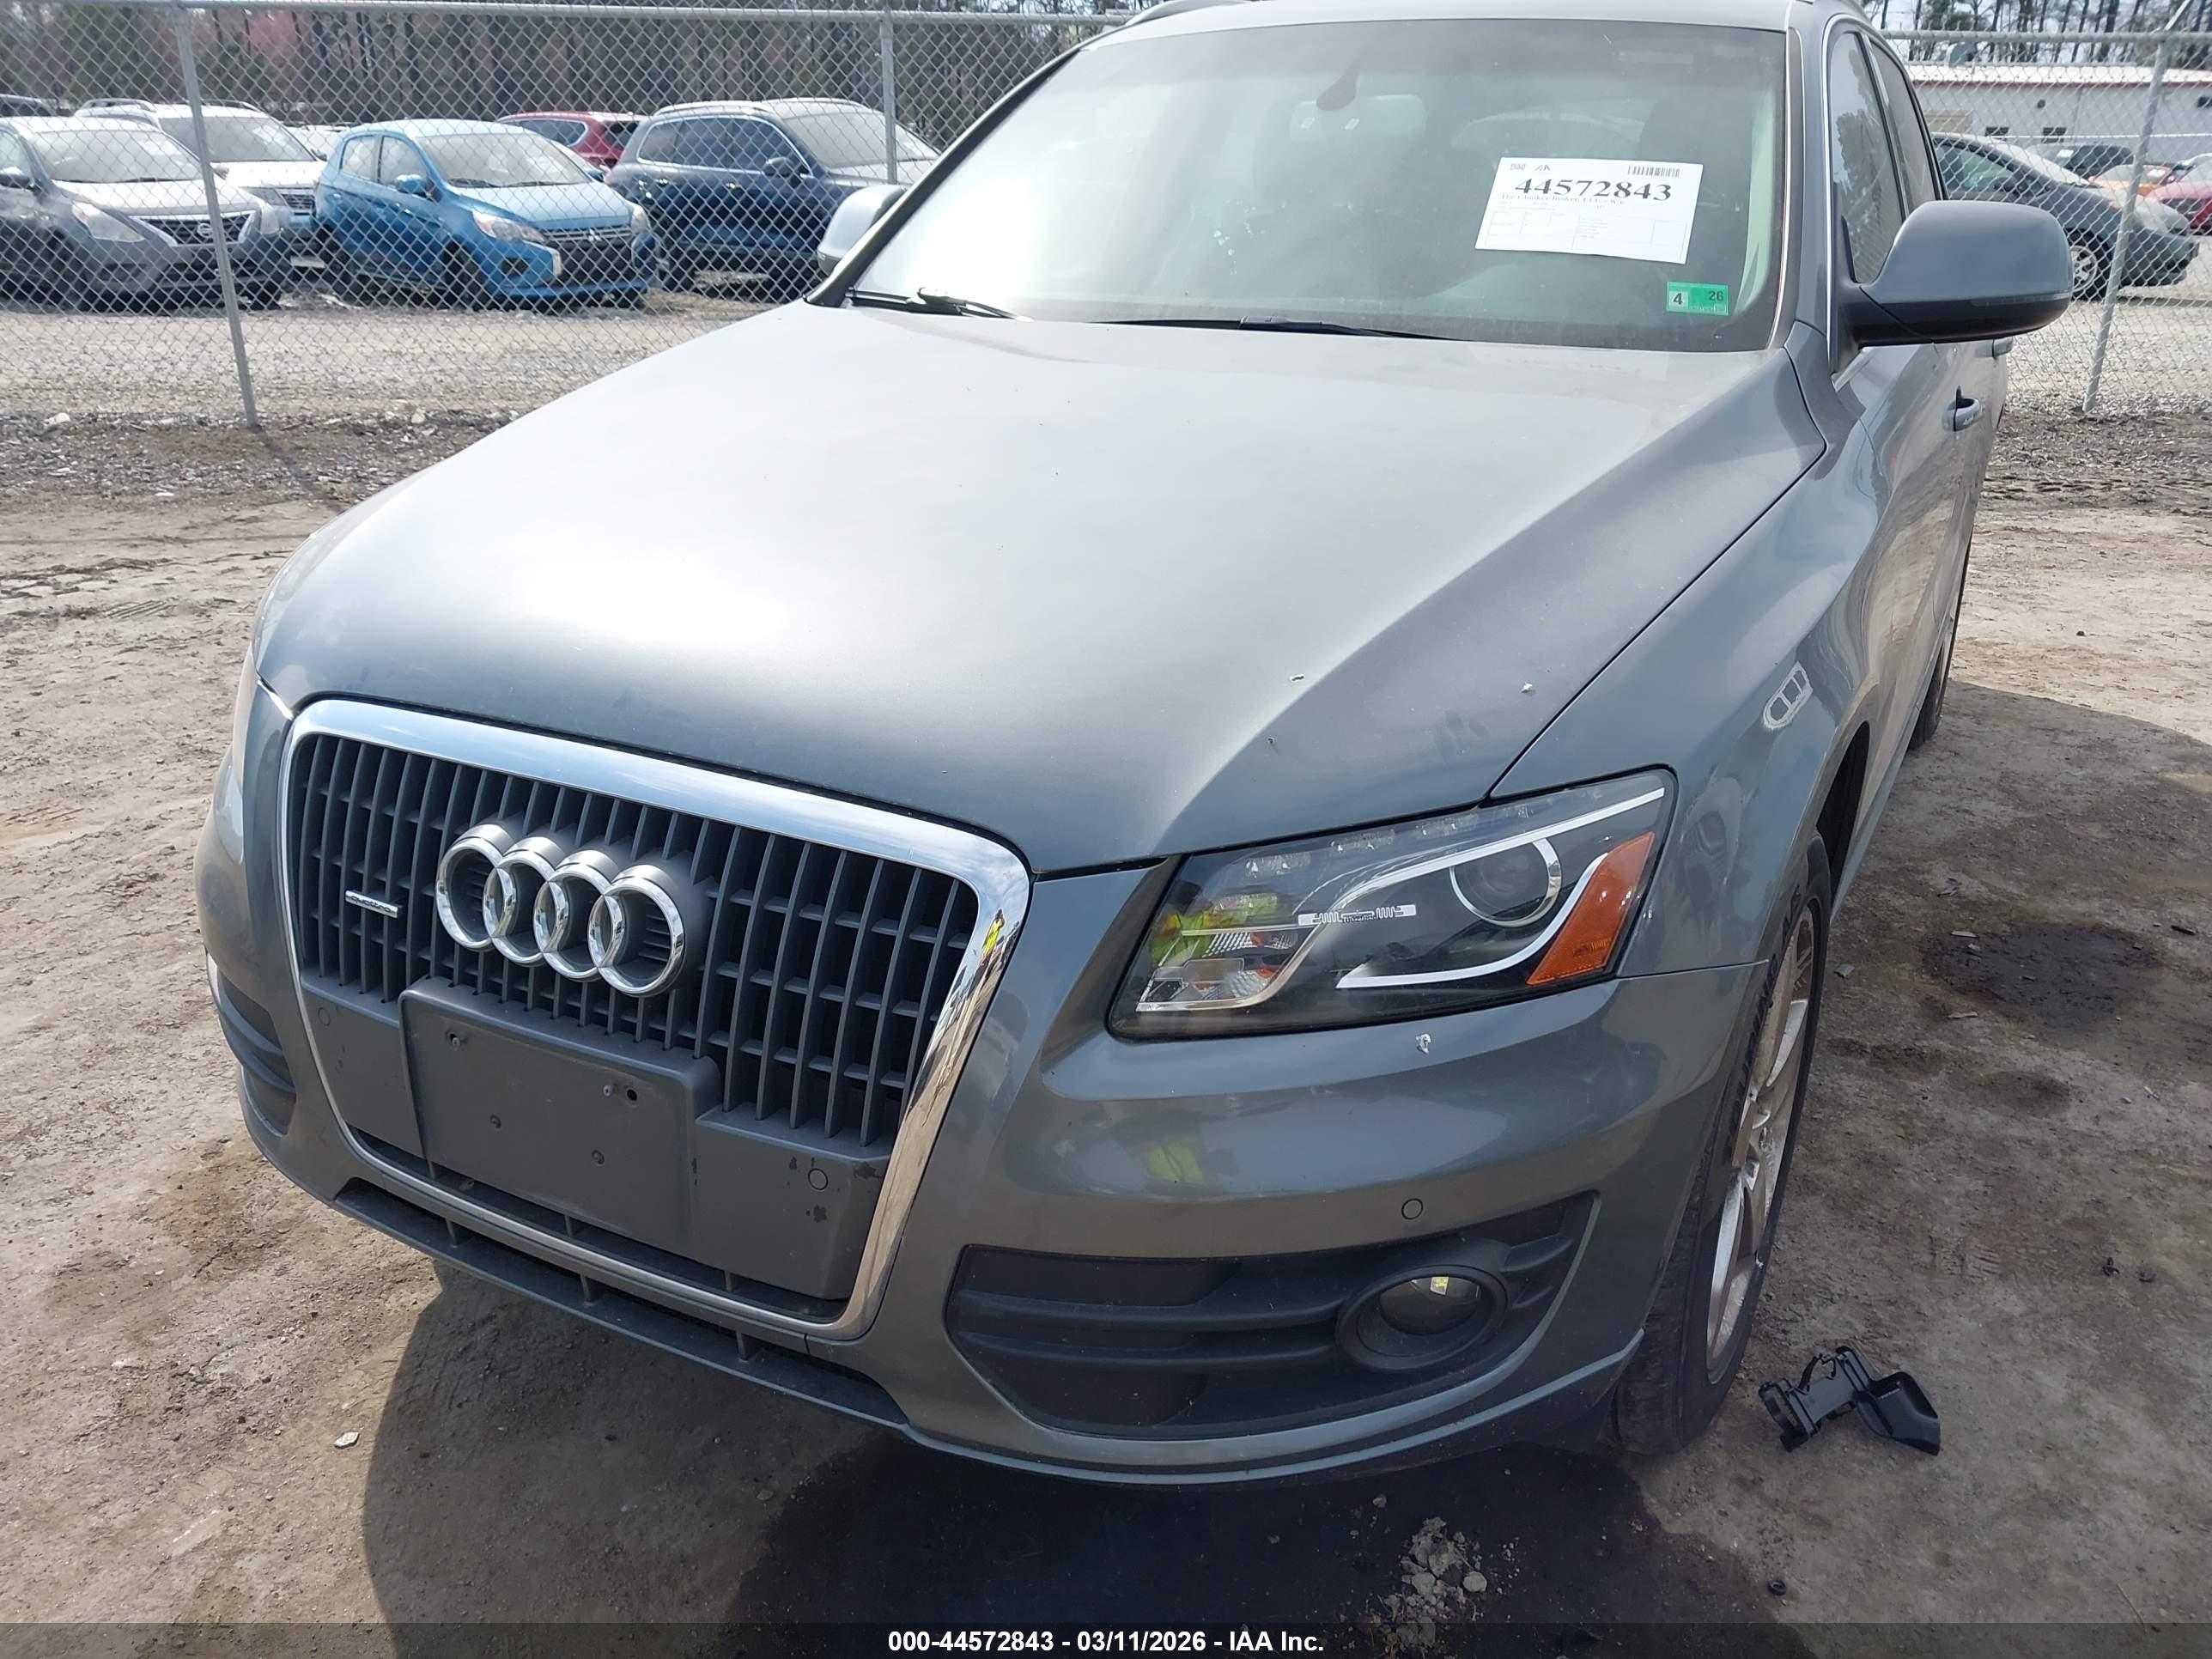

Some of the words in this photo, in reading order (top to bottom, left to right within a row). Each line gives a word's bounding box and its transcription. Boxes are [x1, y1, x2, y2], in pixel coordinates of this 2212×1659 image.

[1514, 178, 1672, 202] 44572843
[1672, 292, 1683, 305] 4
[1708, 289, 1724, 302] 26
[349, 894, 393, 914] quattro
